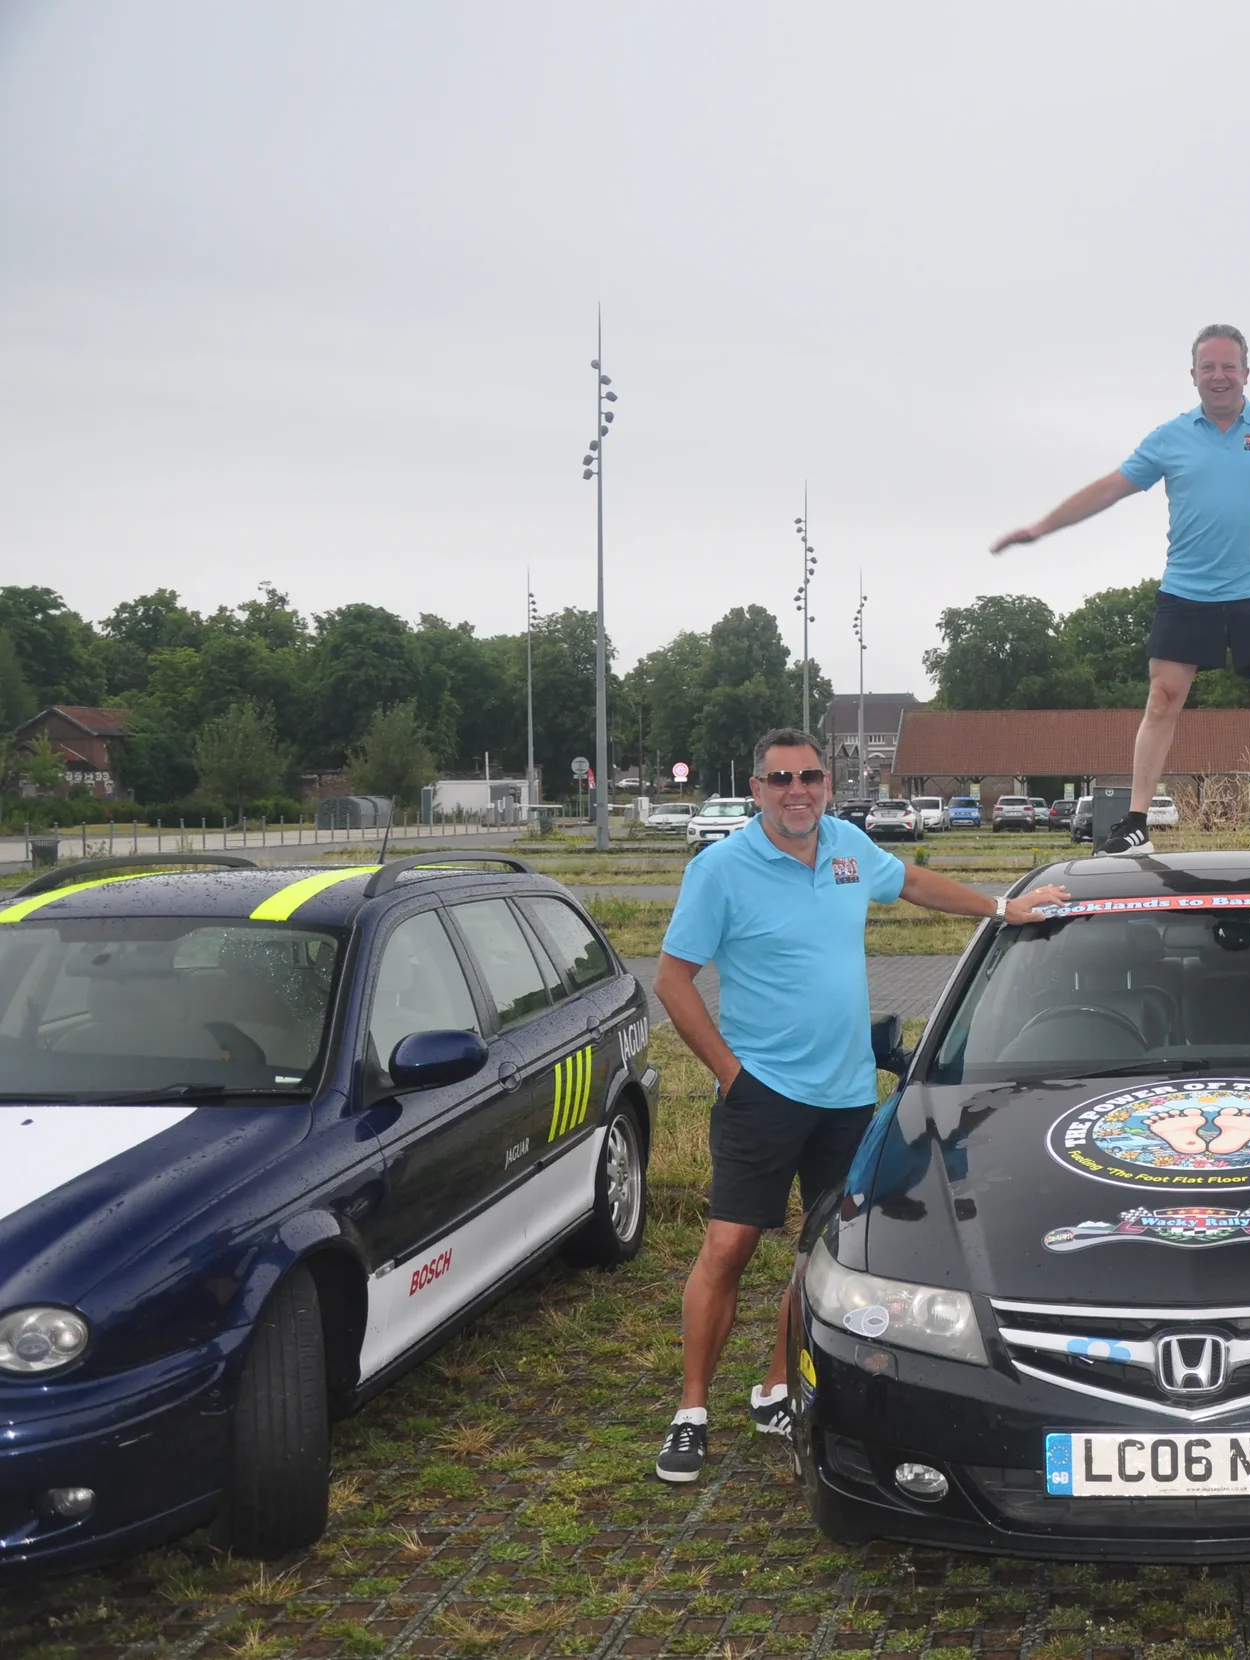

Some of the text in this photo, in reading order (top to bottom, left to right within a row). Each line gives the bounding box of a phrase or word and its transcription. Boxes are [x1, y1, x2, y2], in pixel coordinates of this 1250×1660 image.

[1177, 898, 1205, 907] to
[1183, 1083, 1227, 1091] OF
[1078, 1086, 1178, 1120] POWER
[1065, 1121, 1092, 1148] THE
[505, 1137, 529, 1170] JAGUAR
[1068, 1150, 1104, 1171] Fuelling
[1135, 1173, 1171, 1183] Foot
[1172, 1176, 1204, 1184] Flat
[1208, 1175, 1249, 1184] Floor
[1140, 1217, 1198, 1227] Wacky
[409, 1247, 452, 1297] BOSCH
[1084, 1438, 1212, 1483] LC06
[1052, 1471, 1069, 1484] GB
